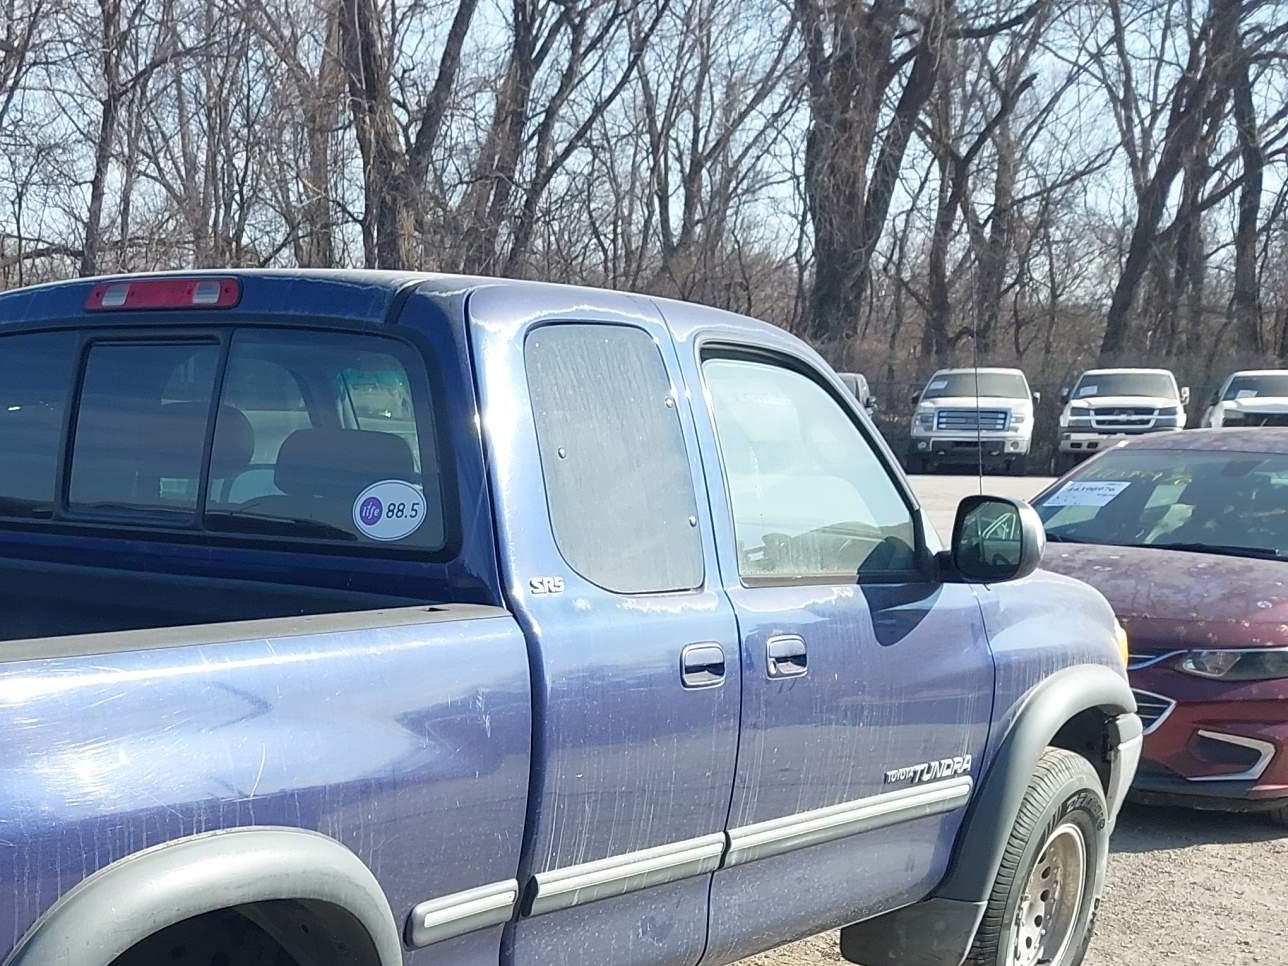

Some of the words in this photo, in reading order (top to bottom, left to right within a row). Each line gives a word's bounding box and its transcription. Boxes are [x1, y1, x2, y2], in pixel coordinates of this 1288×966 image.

[362, 501, 380, 520] life
[385, 502, 420, 519] 88.5
[885, 767, 914, 784] TOYOTA
[912, 754, 972, 782] TUNDRA
